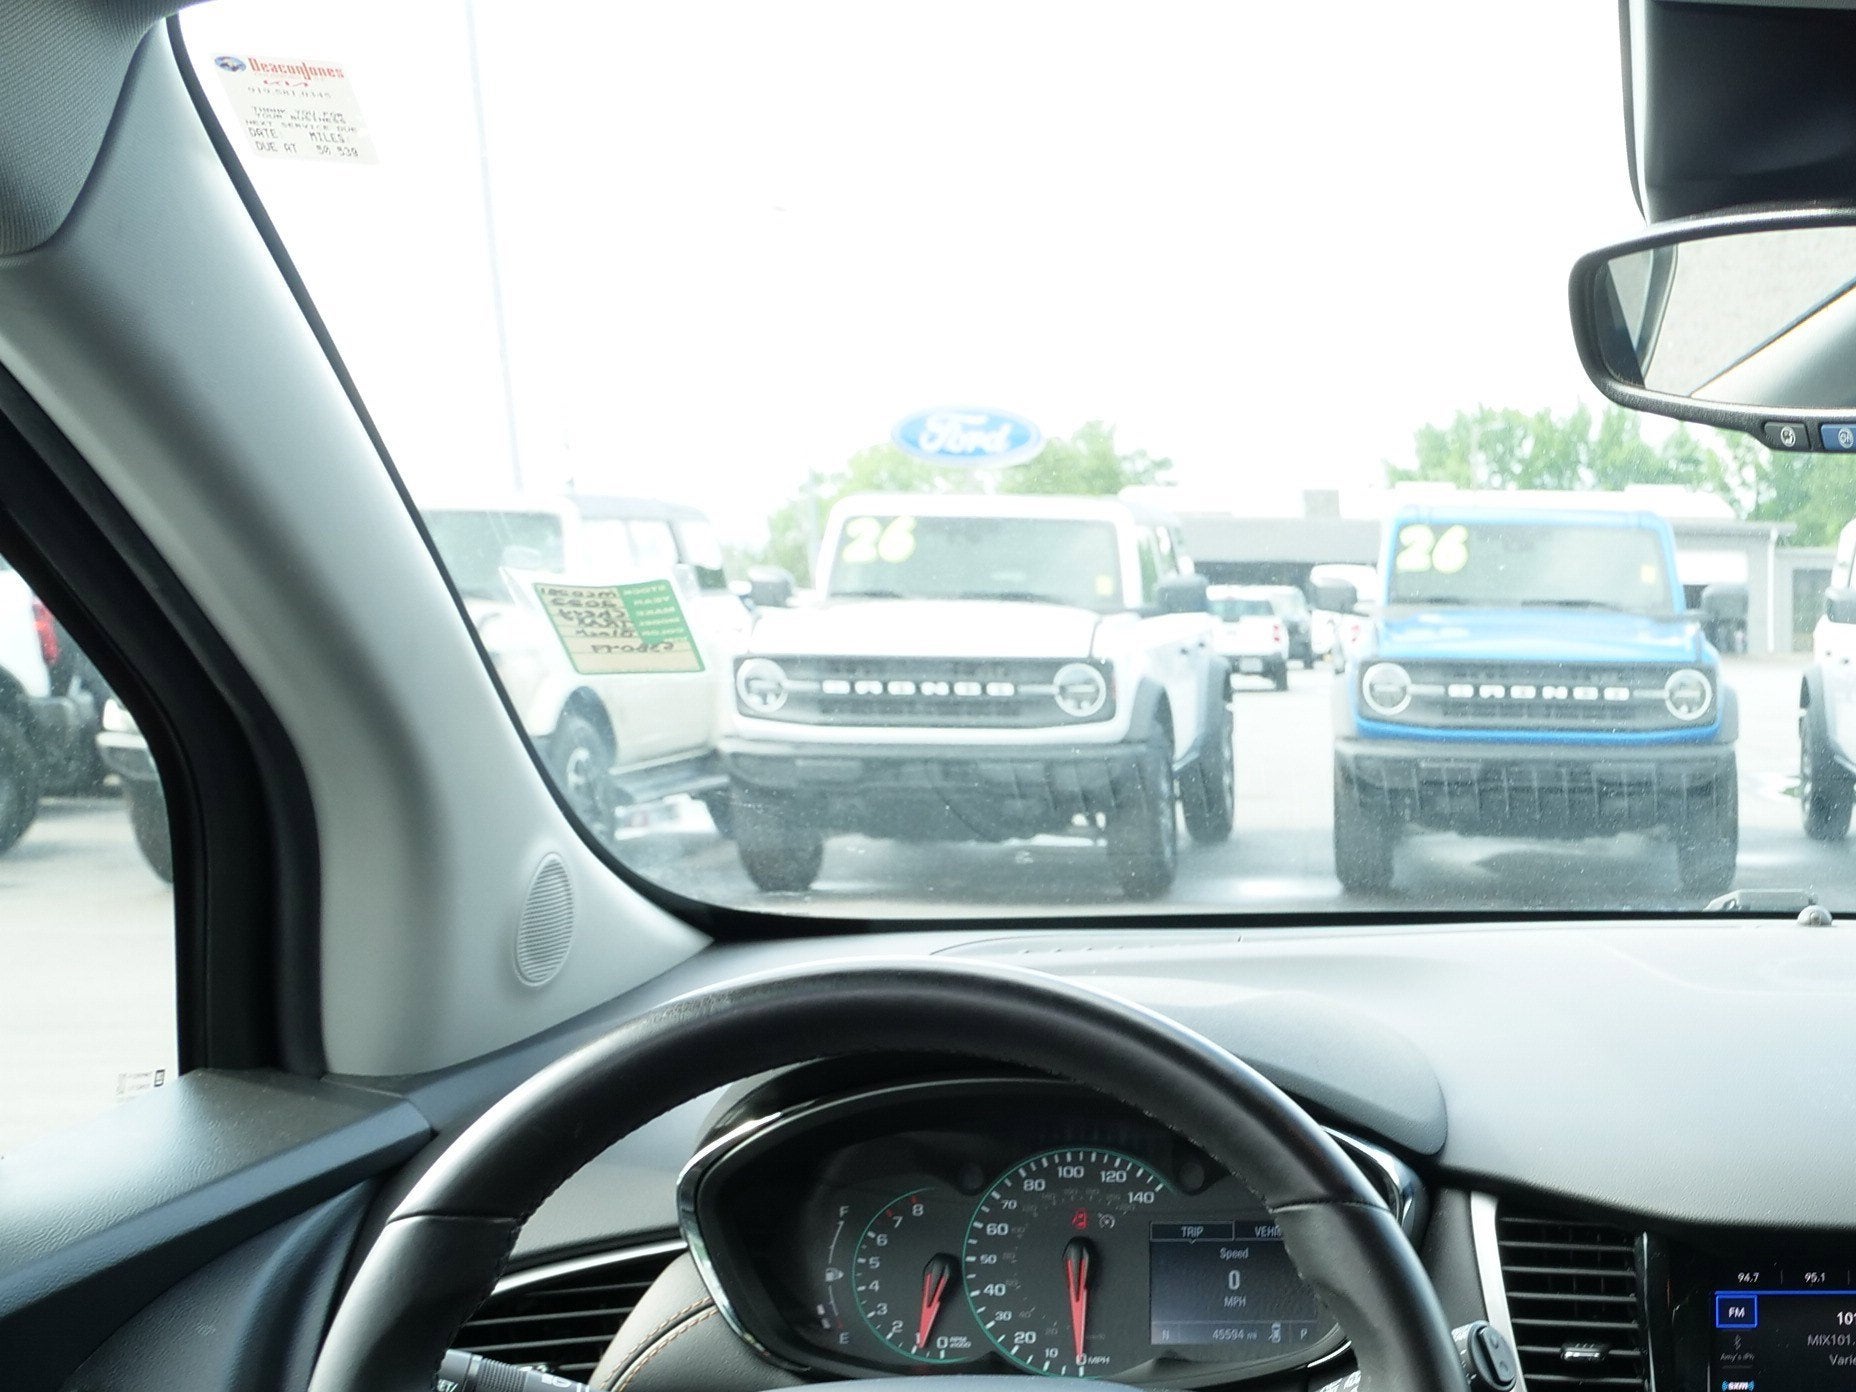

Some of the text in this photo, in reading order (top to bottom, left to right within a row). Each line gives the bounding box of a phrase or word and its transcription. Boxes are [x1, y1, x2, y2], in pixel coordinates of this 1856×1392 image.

[248, 127, 346, 144] DATE MILES
[255, 140, 278, 153] DUE
[284, 143, 299, 153] AT
[918, 413, 1012, 455] Ford
[842, 514, 917, 564] 26
[1396, 523, 1469, 575] 26
[1057, 1165, 1085, 1179] 100
[1100, 1170, 1127, 1183] 120
[1023, 1179, 1046, 1192] 80
[1127, 1191, 1155, 1204] 140
[838, 1205, 850, 1217] F
[912, 1203, 924, 1217] 8
[1001, 1200, 1018, 1210] 70
[892, 1215, 904, 1229] 7
[986, 1222, 1009, 1236] 60
[1181, 1225, 1204, 1238] TRIP
[876, 1233, 888, 1246] 6
[980, 1254, 998, 1264] 50
[1219, 1247, 1250, 1261] Speed
[868, 1256, 881, 1269] 5
[1228, 1269, 1241, 1291] 0
[1737, 1271, 1760, 1283] 94.7
[1804, 1271, 1826, 1283] 95.1
[868, 1279, 880, 1292] 4
[983, 1283, 1006, 1297] 40
[1223, 1296, 1246, 1308] MPH
[876, 1302, 888, 1316] 3
[994, 1310, 1012, 1321] 30
[1728, 1306, 1746, 1319] FM
[891, 1319, 904, 1334] 2
[838, 1332, 849, 1344] E
[936, 1336, 949, 1349] 0
[1014, 1331, 1037, 1344] 20
[1045, 1347, 1059, 1358] 10
[1075, 1353, 1110, 1366] 0 MPH
